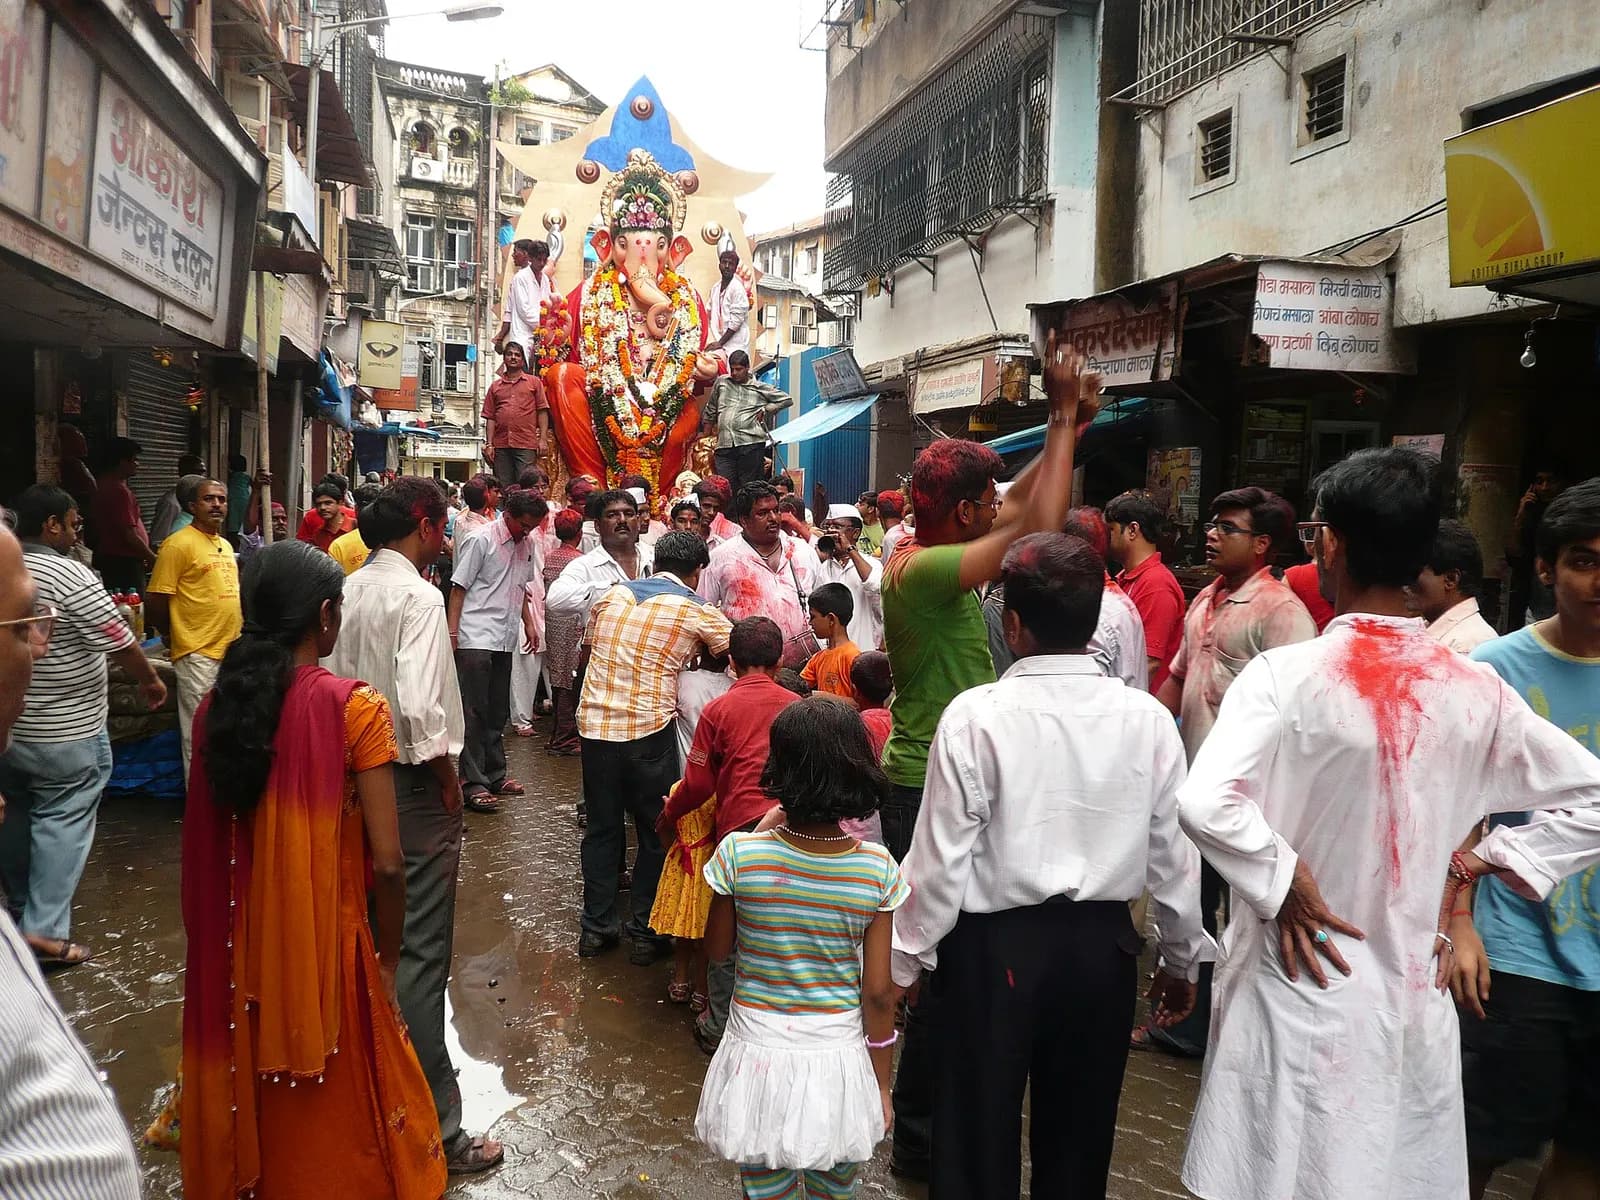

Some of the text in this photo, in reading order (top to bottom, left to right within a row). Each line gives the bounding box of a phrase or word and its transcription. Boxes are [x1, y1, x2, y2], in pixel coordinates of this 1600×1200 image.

[1471, 251, 1565, 281] ADITYA BIRLA GROUP
[1279, 279, 1316, 296] मसाला
[1319, 277, 1350, 297] मिरची
[1282, 308, 1315, 324] मसाला
[1319, 307, 1344, 325] आंबा
[1282, 332, 1313, 351] चटणी
